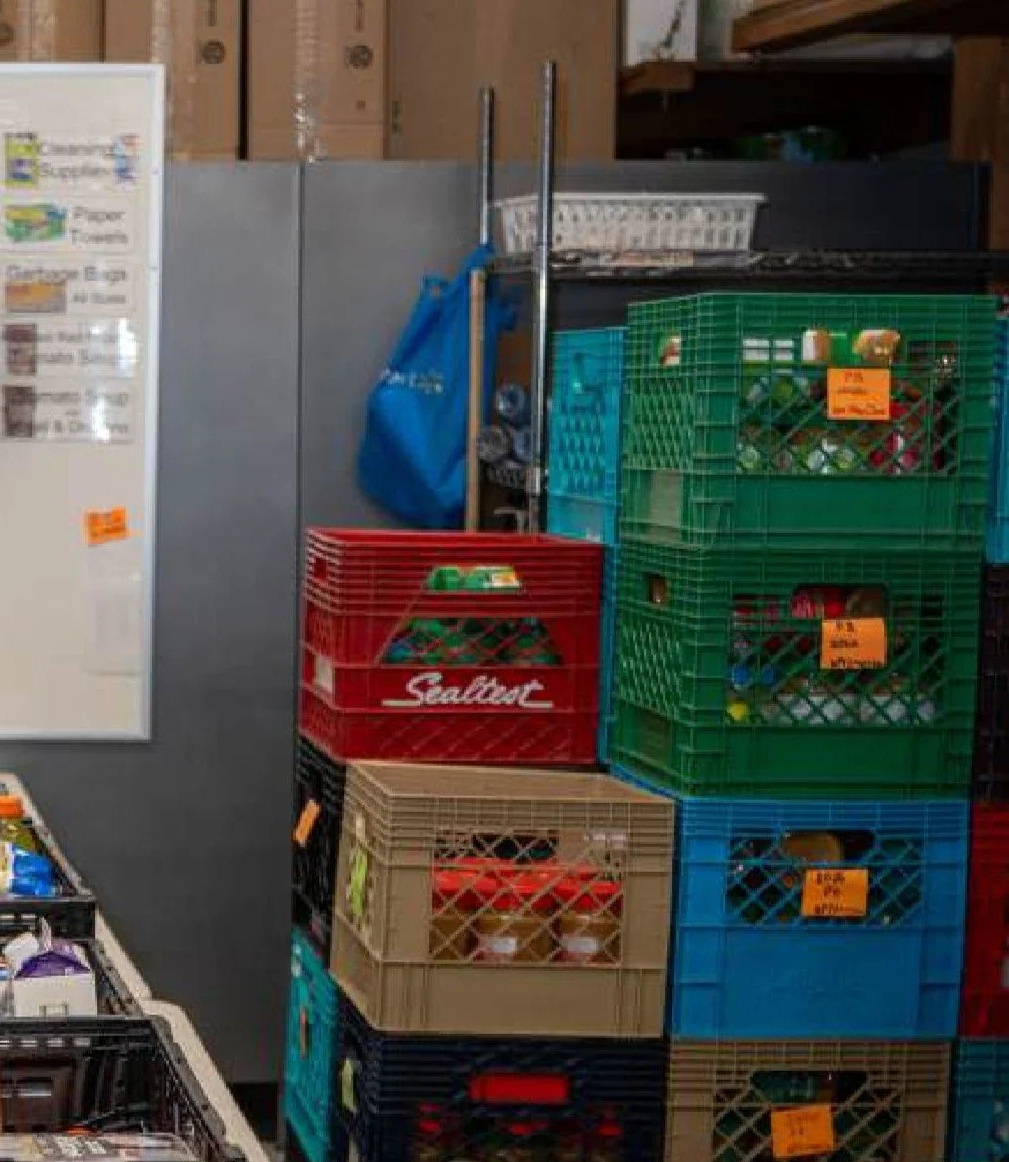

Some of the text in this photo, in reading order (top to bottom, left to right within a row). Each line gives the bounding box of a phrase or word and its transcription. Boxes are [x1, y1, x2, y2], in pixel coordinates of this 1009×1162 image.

[72, 206, 126, 223] Paper
[71, 230, 129, 246] Towels
[404, 671, 545, 706] Sealtest
